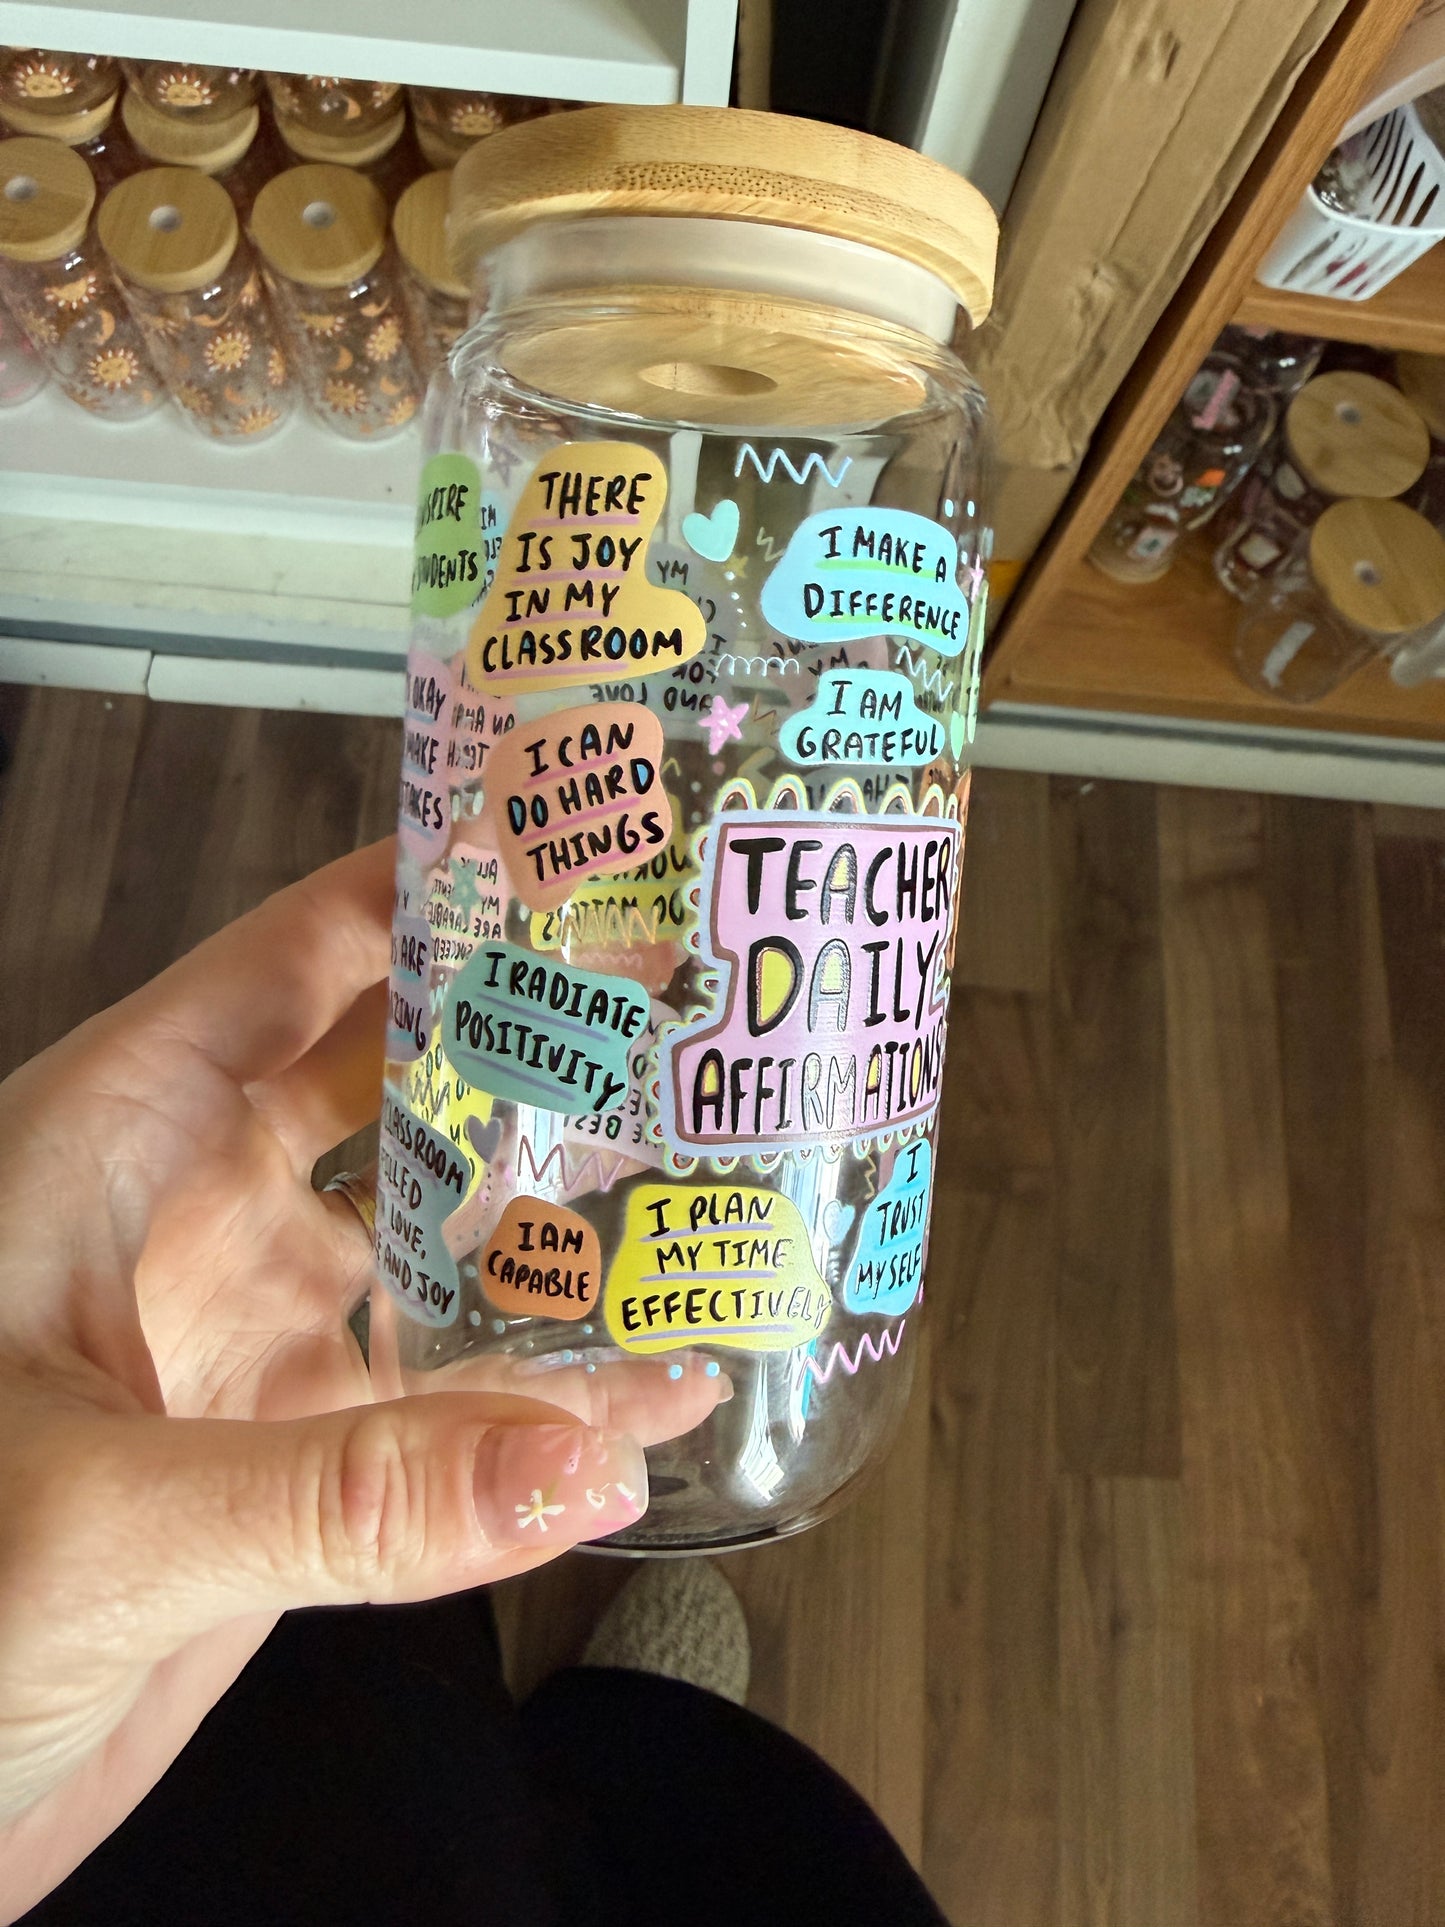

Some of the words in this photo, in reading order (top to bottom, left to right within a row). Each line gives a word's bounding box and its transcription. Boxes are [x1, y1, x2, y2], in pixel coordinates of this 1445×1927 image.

[538, 471, 653, 520] THERE
[515, 531, 553, 573] IS
[570, 532, 644, 572] JOY
[817, 525, 843, 559] I
[852, 525, 927, 574] MAKE
[934, 556, 947, 583] A
[504, 587, 550, 622] IN
[564, 579, 621, 618] MY
[803, 583, 961, 640] DIFFERENCE
[482, 624, 683, 673] CLASSROOM
[825, 680, 853, 716] I
[858, 687, 903, 721] AM
[524, 738, 550, 777] I
[558, 721, 635, 768] CAN
[796, 723, 939, 762] GRATEFUL
[507, 795, 550, 836] DO
[558, 757, 656, 815] HARD
[526, 812, 665, 882] THINGS
[729, 837, 952, 927] TEACHER
[401, 934, 427, 977] ARE
[484, 951, 506, 987] I
[510, 960, 646, 1038] RADIATE
[747, 930, 940, 1037] DAILY
[455, 1000, 626, 1112] POSITIVITY
[692, 1020, 944, 1135] AFFIRMATIONS
[905, 1142, 923, 1184] I
[518, 1221, 534, 1252] I
[541, 1221, 584, 1255] AM
[646, 1197, 672, 1237] I
[690, 1192, 774, 1232] PLAN
[877, 1193, 925, 1246] TRUST
[384, 1242, 412, 1290] AND
[416, 1271, 455, 1315] JOY
[487, 1248, 590, 1302] CAPABLE
[656, 1240, 704, 1275] MY
[712, 1238, 793, 1270] TIME
[854, 1245, 921, 1300] MYSELF
[621, 1286, 832, 1332] EFFECTIVELY
